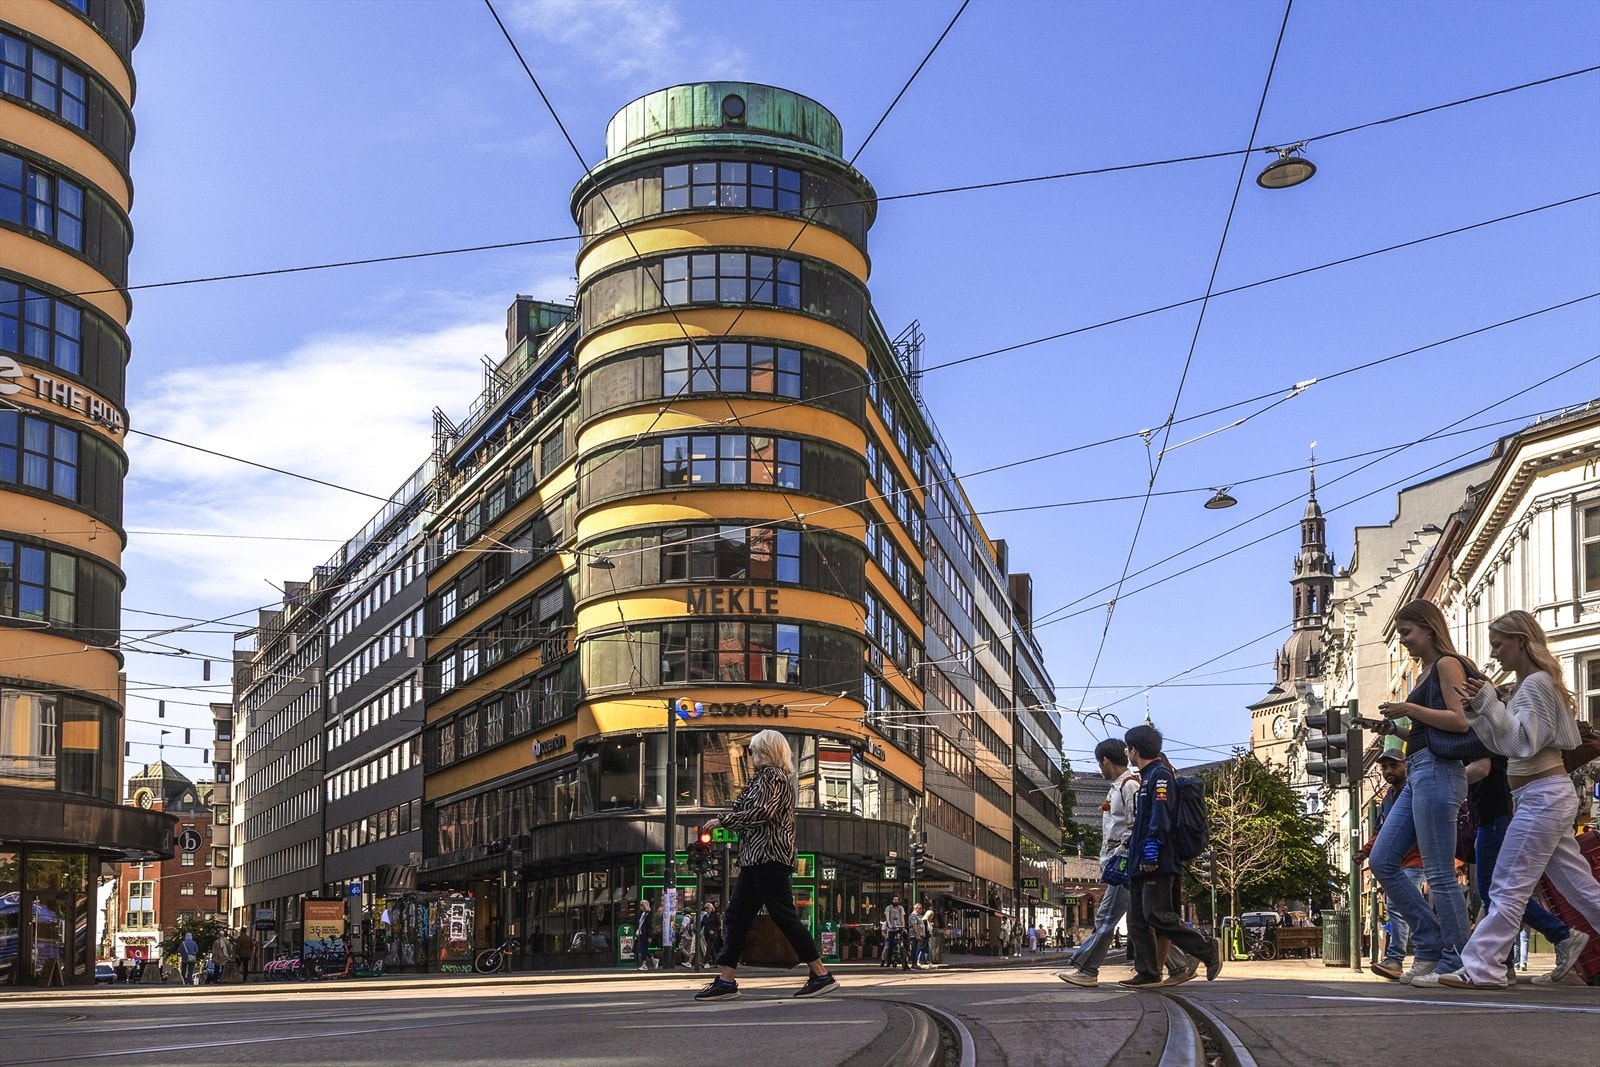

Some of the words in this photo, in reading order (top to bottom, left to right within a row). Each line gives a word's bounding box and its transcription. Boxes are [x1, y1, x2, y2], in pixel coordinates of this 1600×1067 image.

[32, 373, 84, 414] THE
[687, 588, 779, 614] MEKLE
[541, 630, 568, 664] MEKLE
[709, 700, 788, 718] azerion
[1023, 879, 1038, 887] XXL
[309, 925, 321, 935] 35
